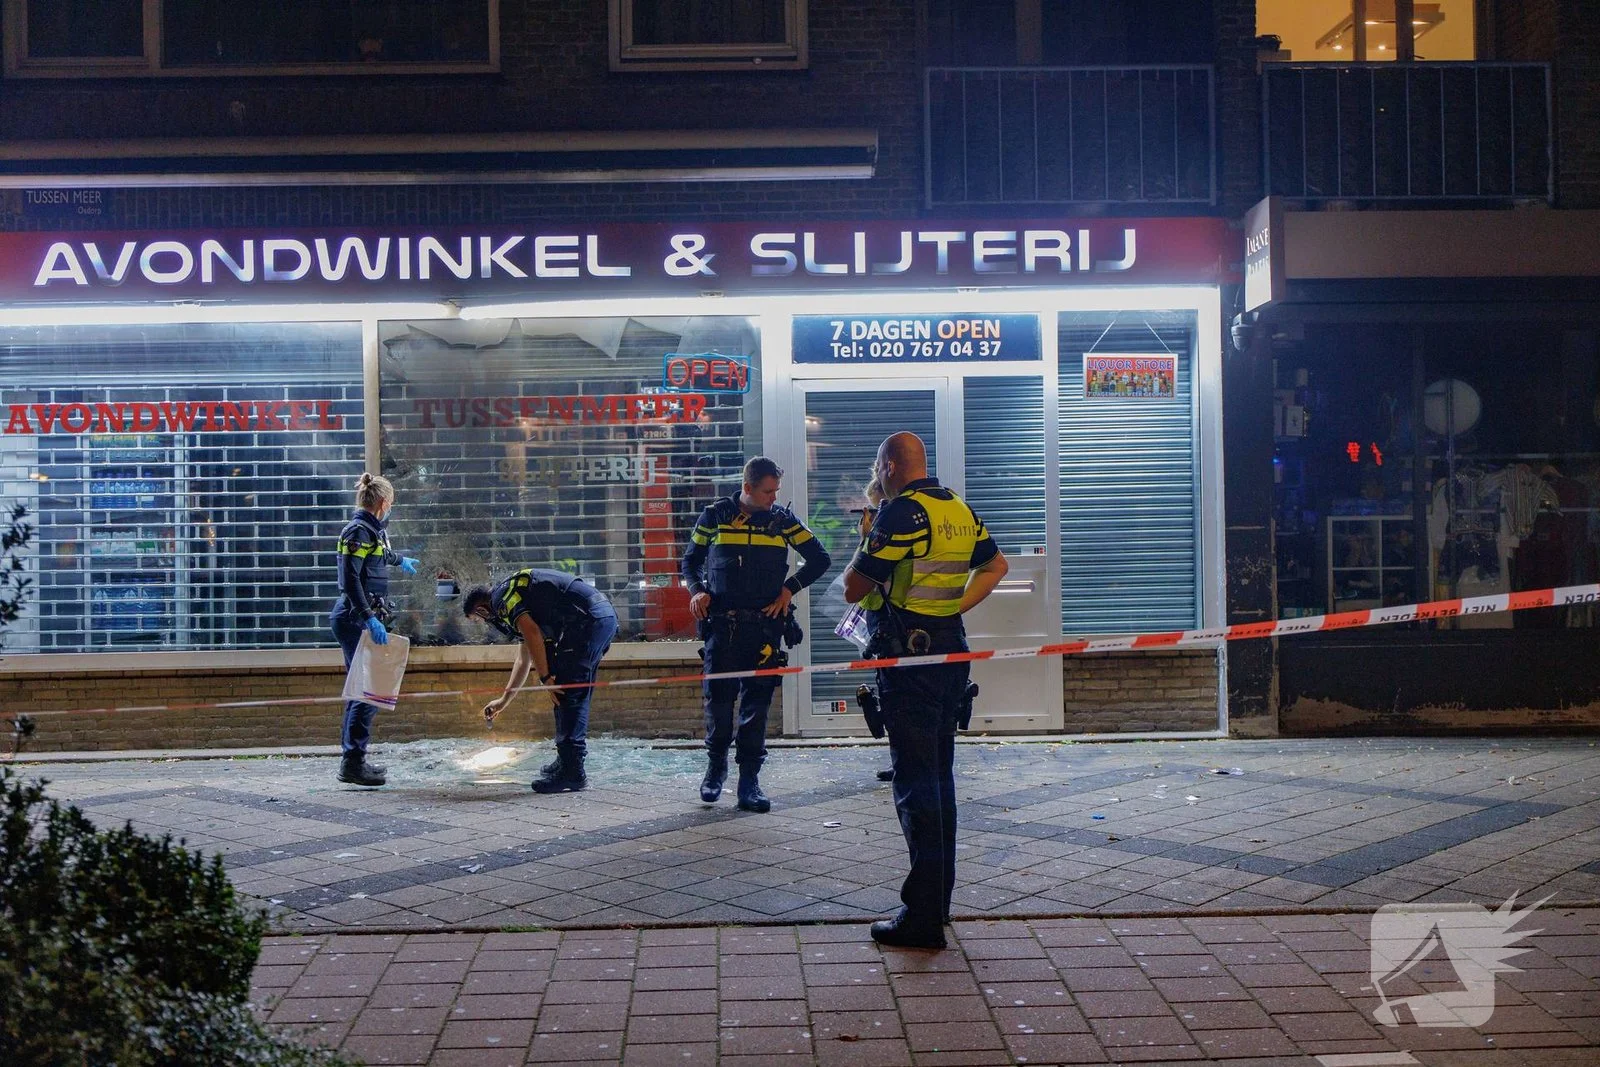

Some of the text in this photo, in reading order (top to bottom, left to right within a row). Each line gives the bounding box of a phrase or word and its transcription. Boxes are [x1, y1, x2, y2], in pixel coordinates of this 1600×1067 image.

[26, 190, 102, 204] TUSSEN MEER
[34, 228, 1136, 287] AVONDWINKEL & SLIJTERIJ
[830, 319, 1000, 340] 7 DAGEN OPEN
[830, 341, 1001, 358] Tel: 020 767 04 37
[667, 358, 748, 388] OPEN
[1088, 359, 1173, 371] LIQUOR STORE
[4, 400, 342, 434] AVONDWINKEL
[413, 393, 707, 428] TUSSENMEER
